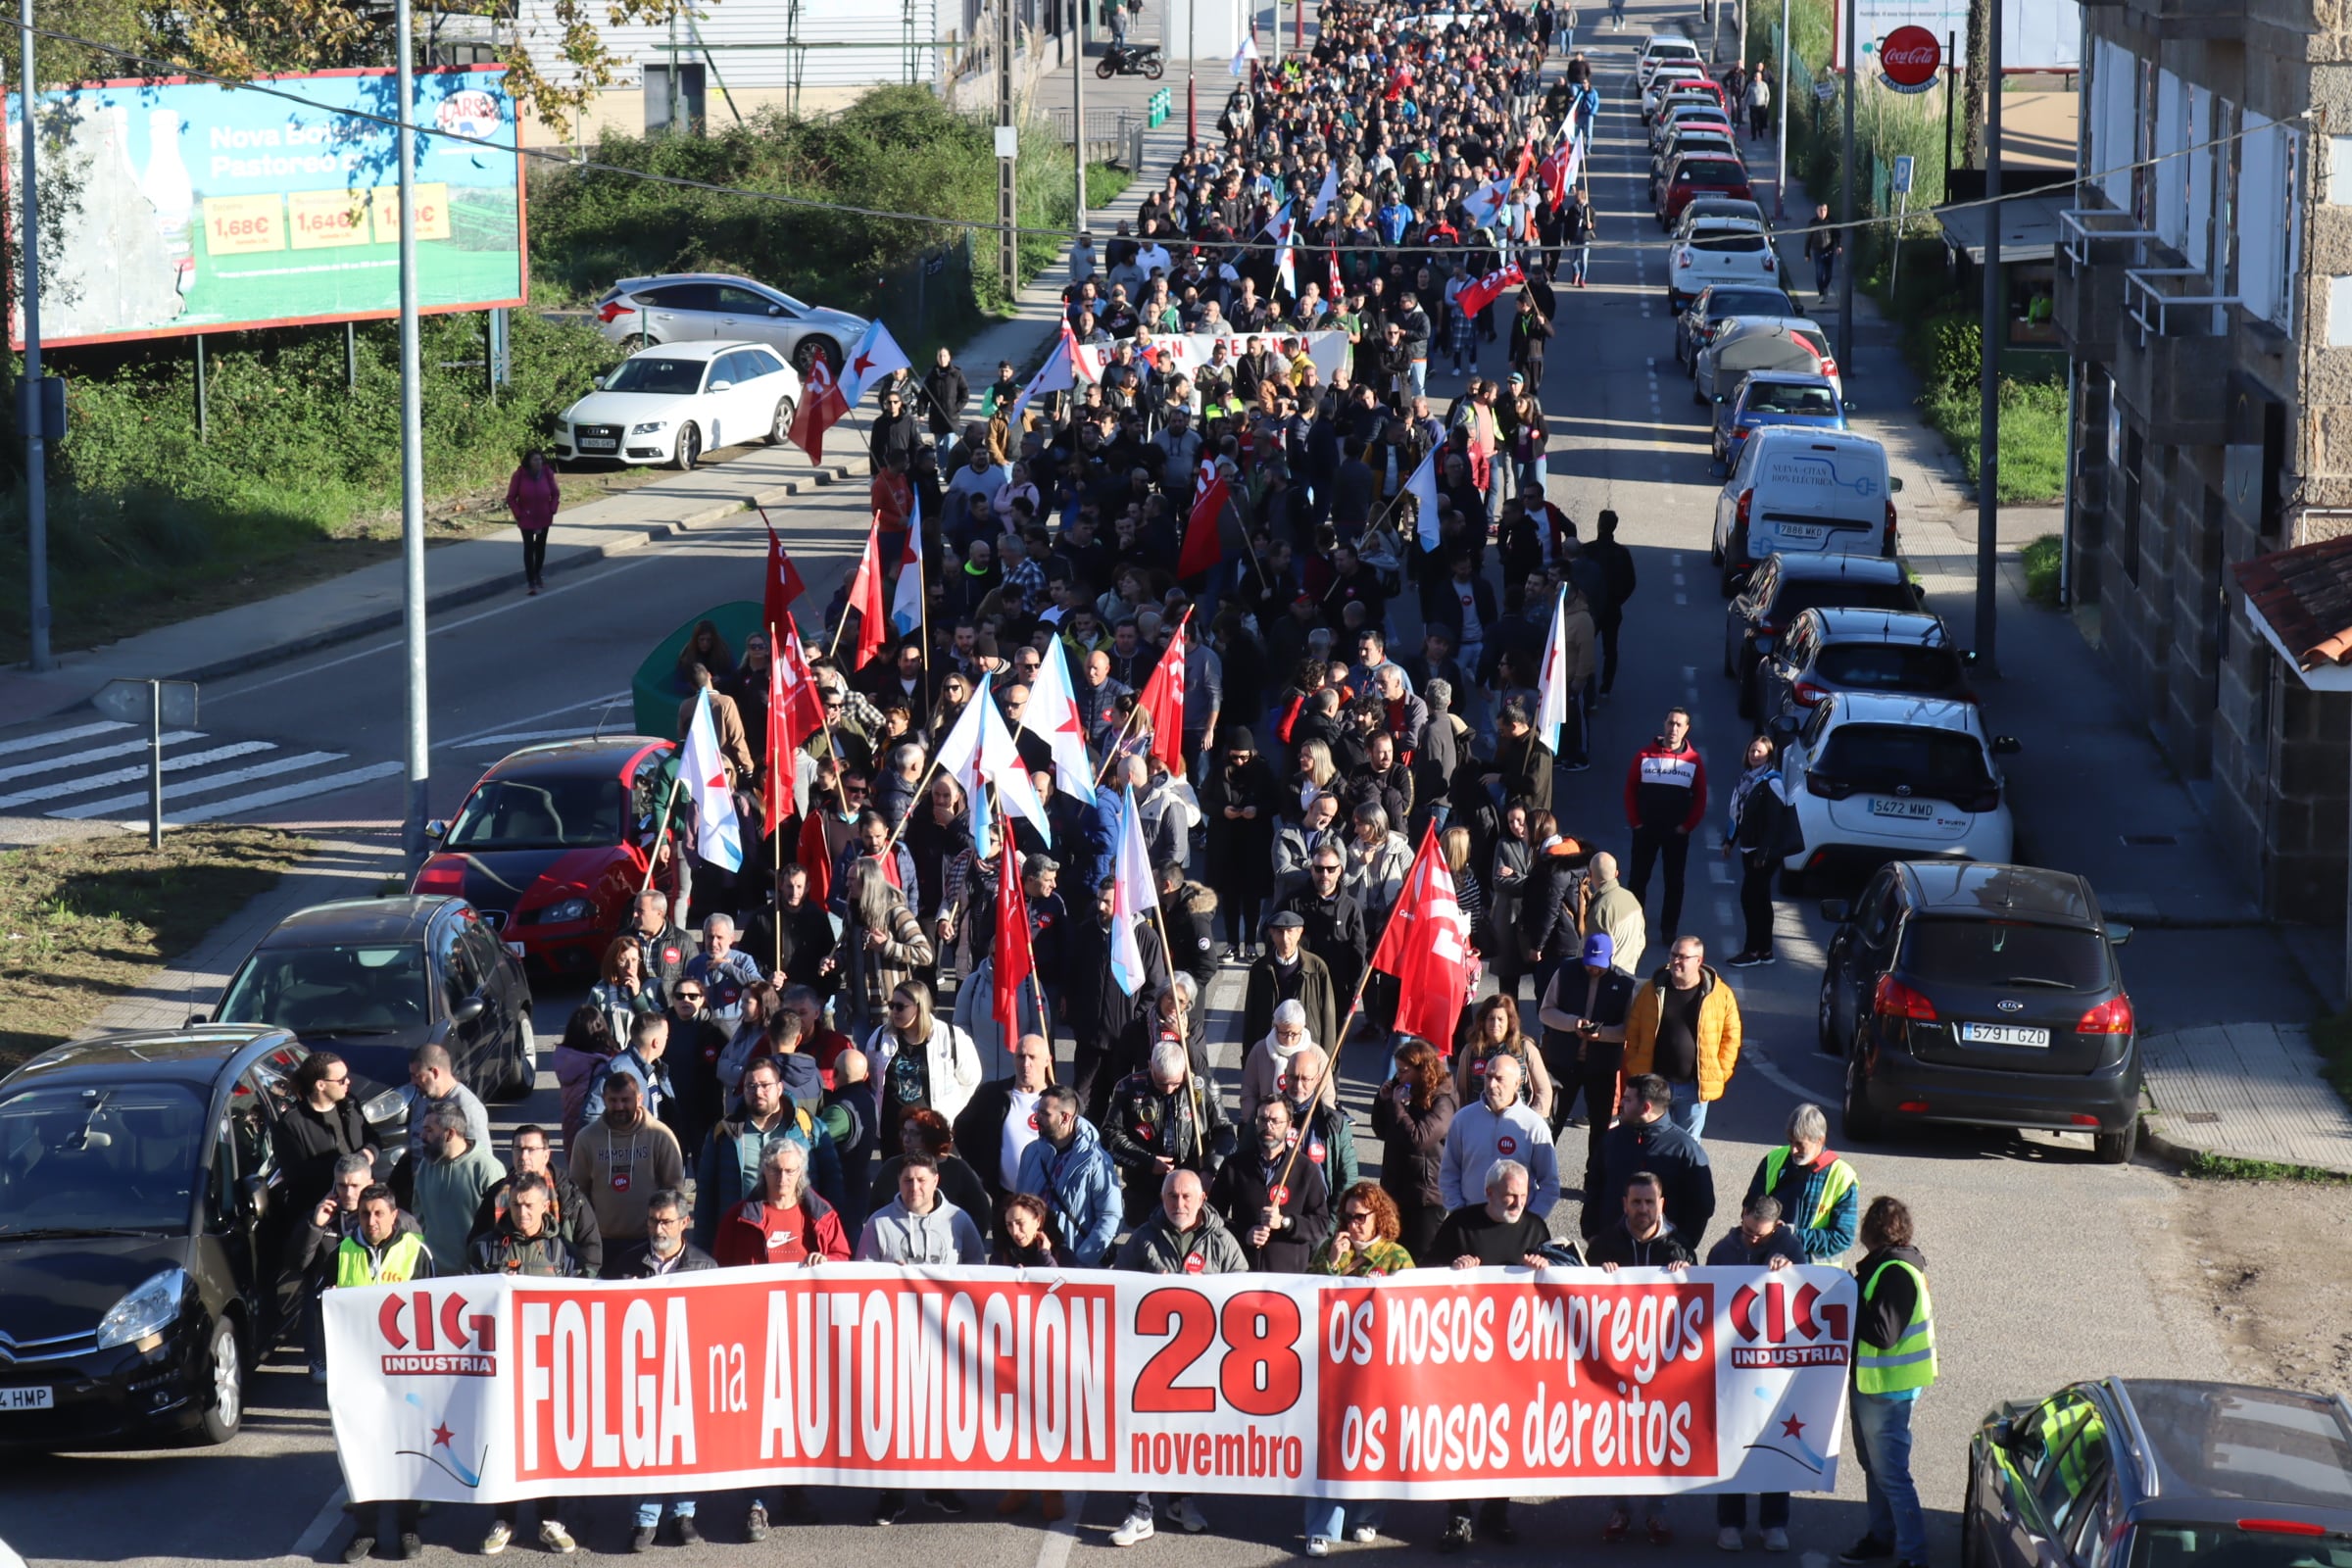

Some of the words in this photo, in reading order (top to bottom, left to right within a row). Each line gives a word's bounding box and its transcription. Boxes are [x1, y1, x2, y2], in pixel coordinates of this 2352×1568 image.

[210, 125, 280, 149] Nova
[211, 153, 336, 178] Pastoreo
[214, 217, 270, 238] 1,68€
[296, 211, 353, 232] 1,64€
[1876, 801, 1905, 814] 5472
[1909, 804, 1934, 816] MMD
[1974, 1025, 2010, 1041] 5791
[2018, 1030, 2046, 1045] GZD
[378, 1292, 497, 1351] CIG
[1730, 1282, 1848, 1343] CIG
[1132, 1287, 1302, 1416] 28
[1329, 1299, 1374, 1365] os
[1386, 1296, 1495, 1365] nosos
[1507, 1295, 1704, 1388] empregos
[384, 1356, 492, 1373] INDUSTRIA
[1735, 1348, 1844, 1365] INDUSTRIA
[522, 1297, 697, 1471] FOLGA
[709, 1342, 748, 1413] na
[760, 1276, 1106, 1462] AUTOMOCIÓN
[12, 1389, 47, 1407] HMP
[1342, 1404, 1388, 1471] os
[1399, 1401, 1510, 1472] nosos
[1522, 1381, 1691, 1468] dereitos
[1131, 1425, 1302, 1480] novembro
